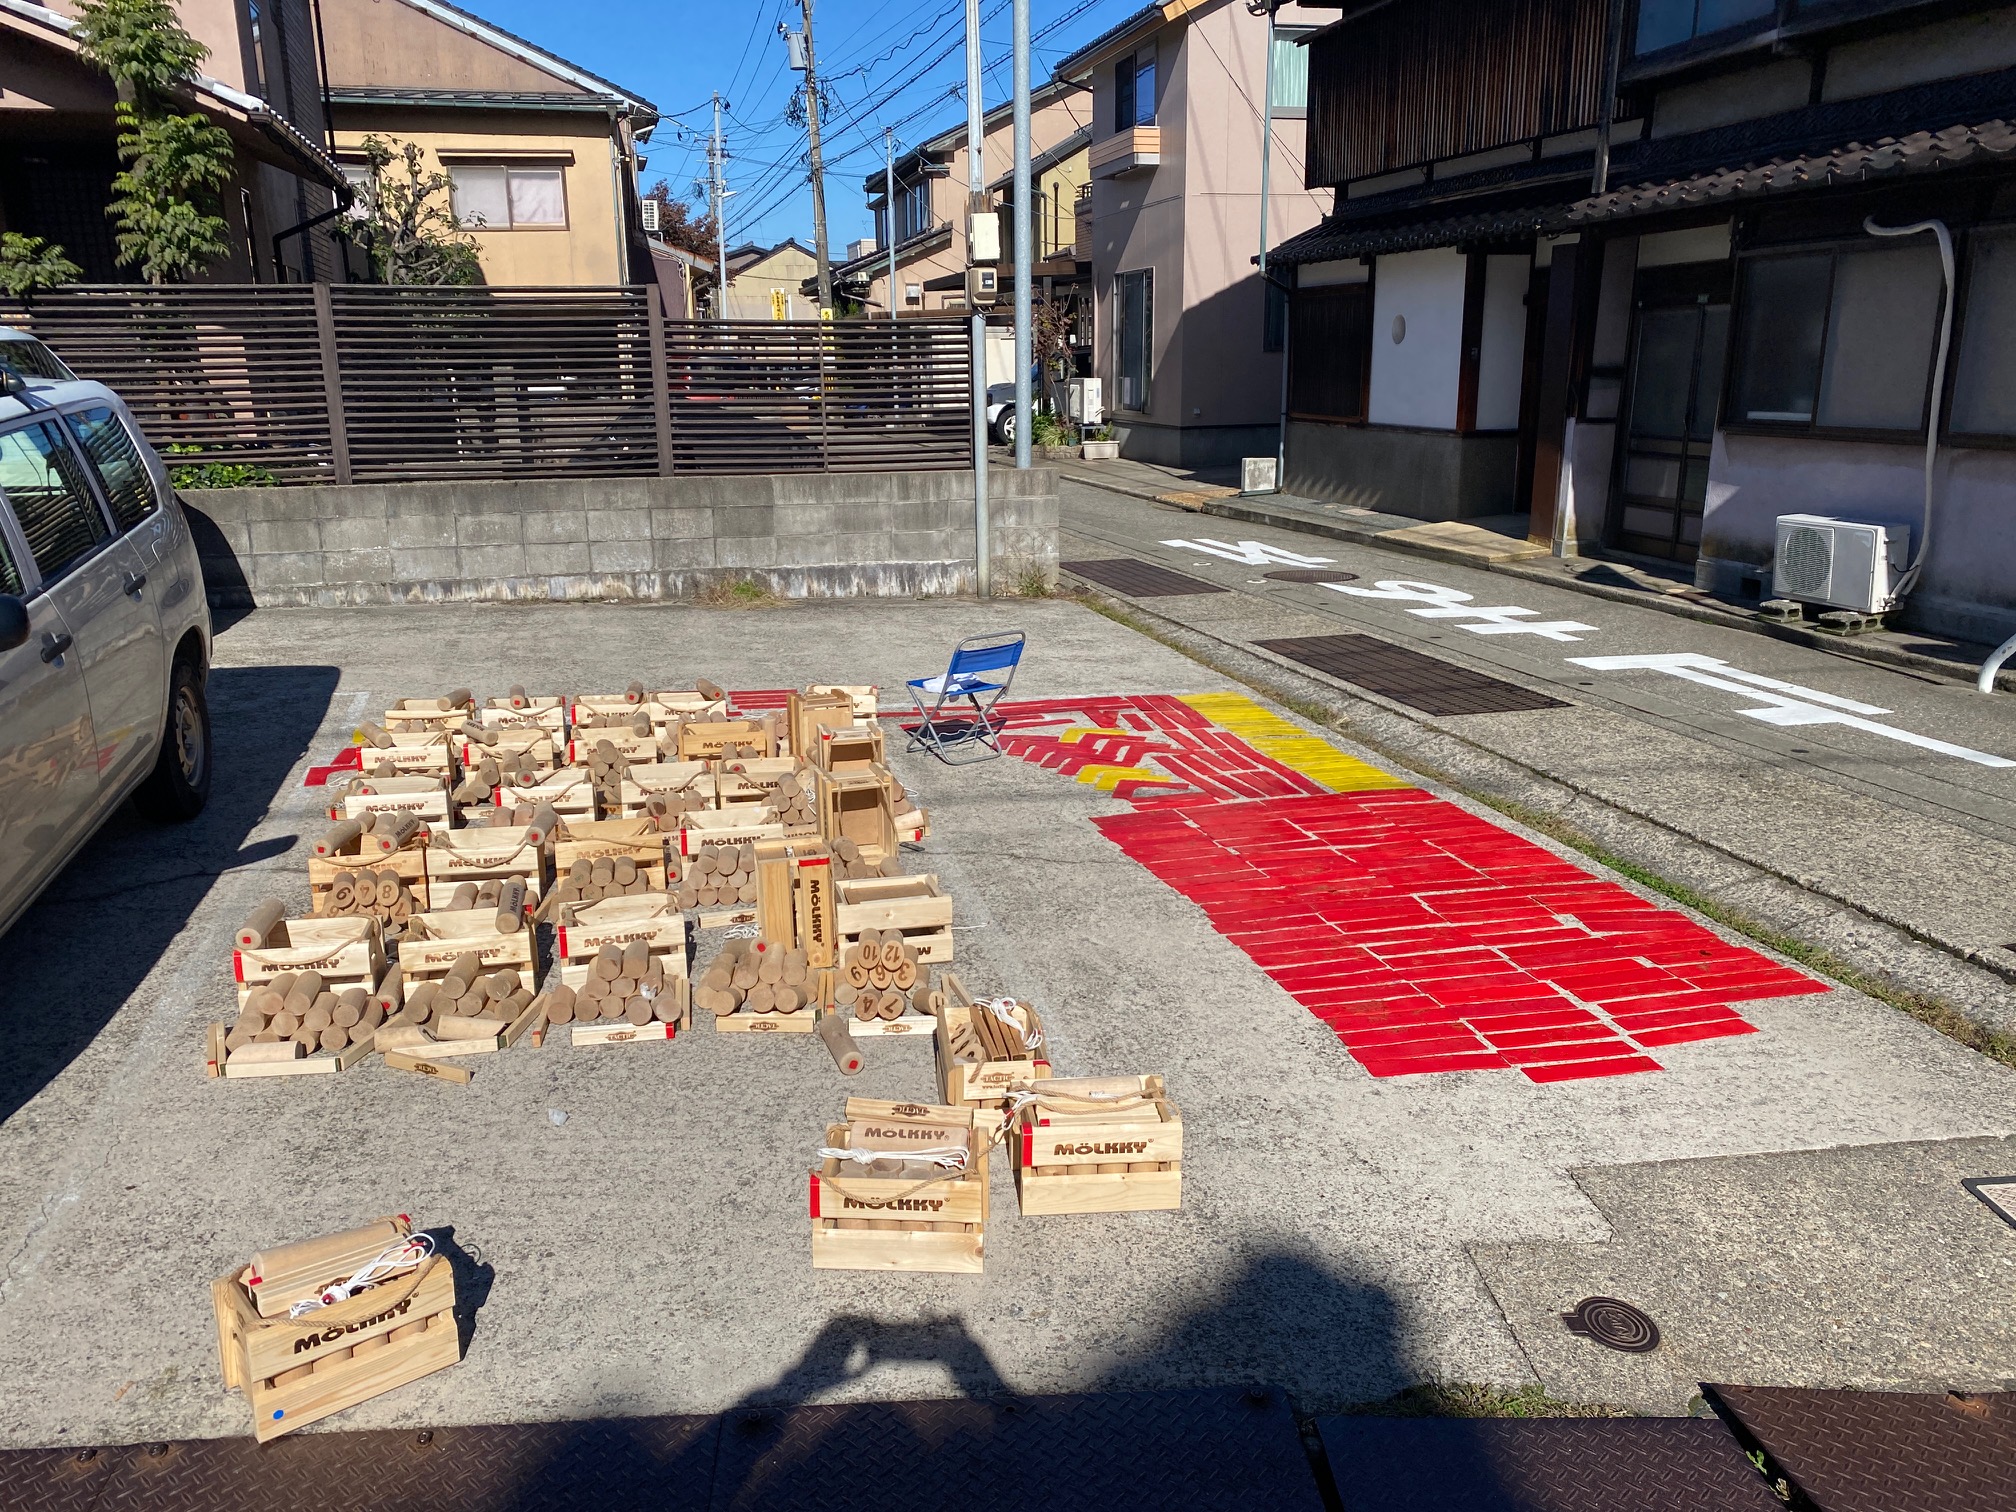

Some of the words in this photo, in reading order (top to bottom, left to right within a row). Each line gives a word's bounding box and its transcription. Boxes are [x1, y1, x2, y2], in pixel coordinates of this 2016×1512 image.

[381, 884, 392, 899] 8
[811, 879, 823, 943] MÖLKKY
[862, 944, 878, 962] 10
[884, 944, 901, 963] 12
[862, 996, 874, 1014] 4
[884, 998, 899, 1014] 7
[609, 1032, 633, 1040] TACTIC
[984, 1074, 1011, 1082] TACTIC
[896, 1106, 926, 1116] TACTIC
[864, 1127, 945, 1140] MÖLKKY
[1053, 1142, 1148, 1156] MÖLKKY
